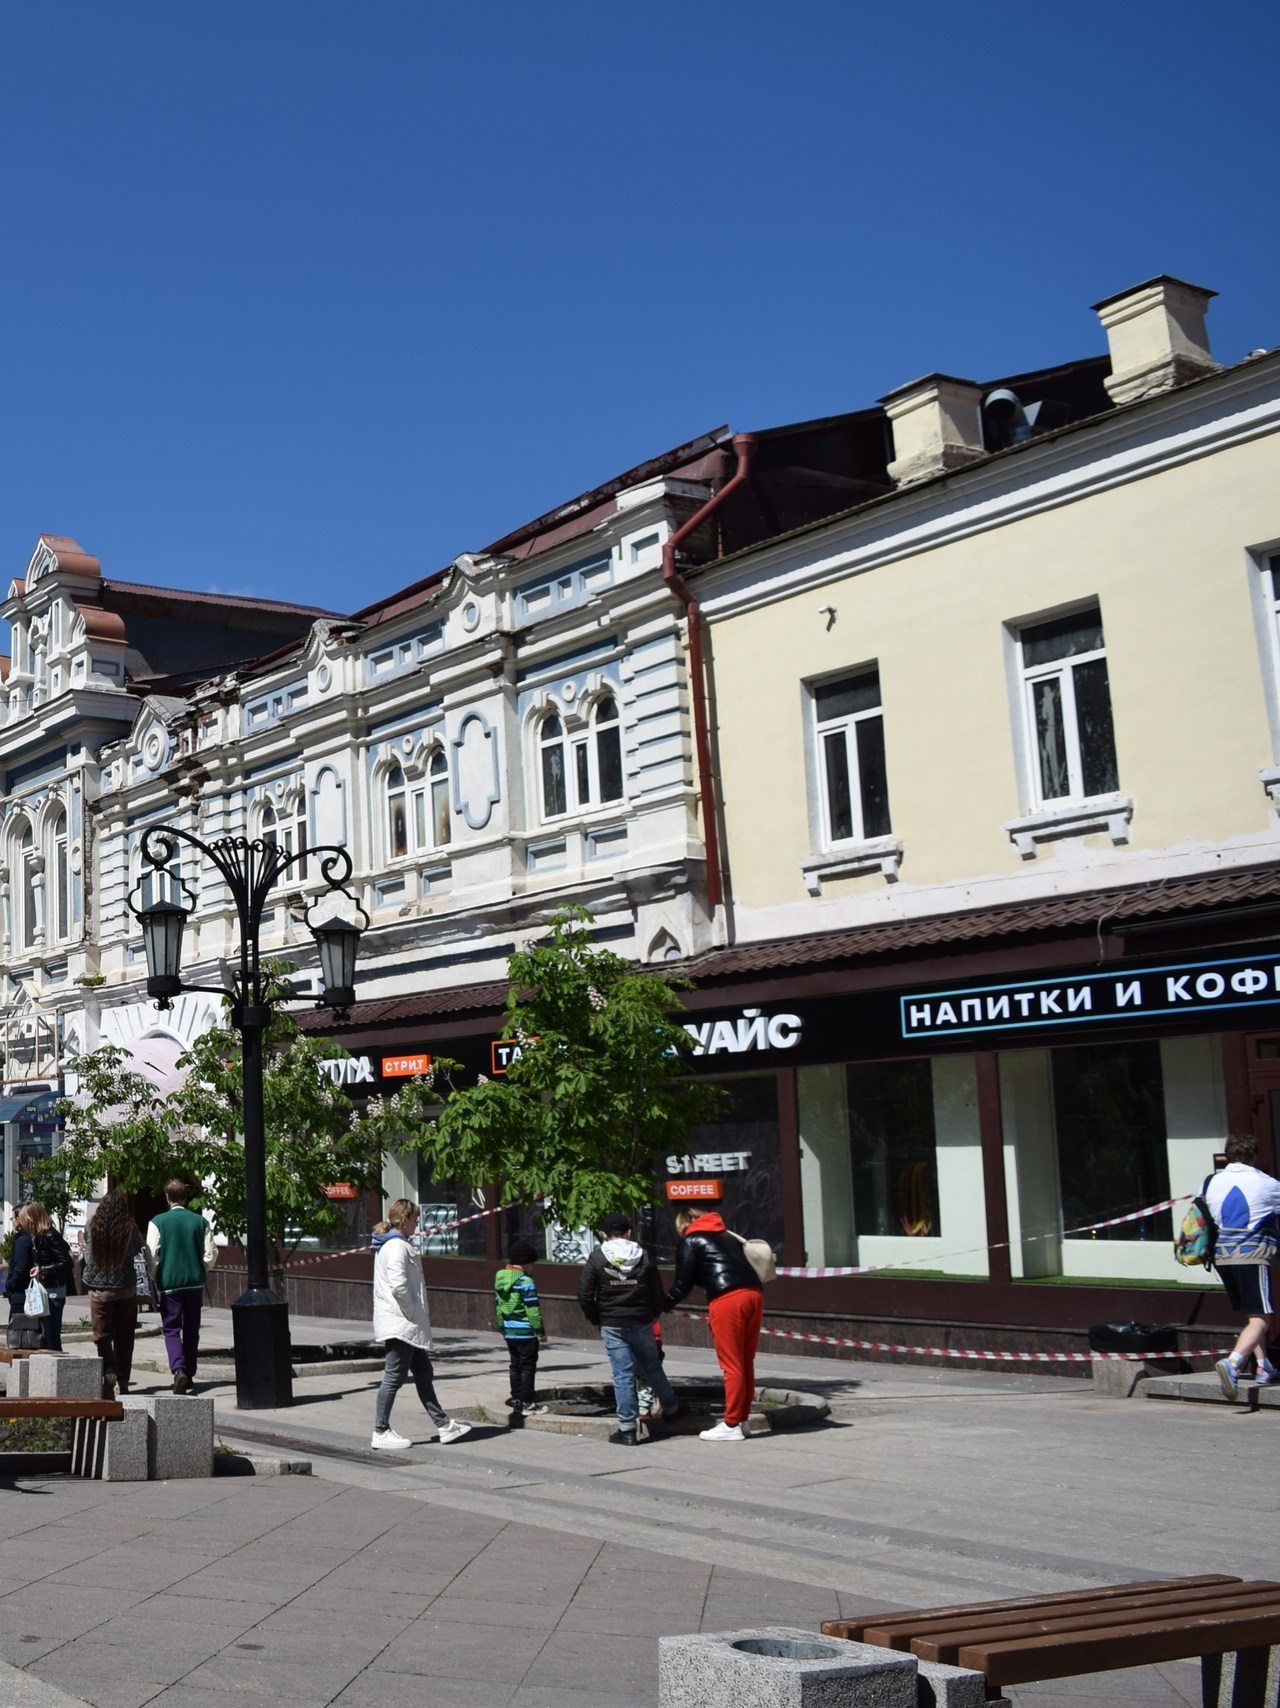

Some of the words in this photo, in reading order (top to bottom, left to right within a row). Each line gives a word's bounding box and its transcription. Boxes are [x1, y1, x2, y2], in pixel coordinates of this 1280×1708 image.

[909, 986, 1093, 1027] НАПИТКИ
[1115, 981, 1142, 1007] И
[385, 1060, 424, 1073] СТРИТ
[666, 1152, 752, 1174] STREET
[324, 1186, 350, 1195] OFFEE
[670, 1185, 714, 1195] COFFEE
